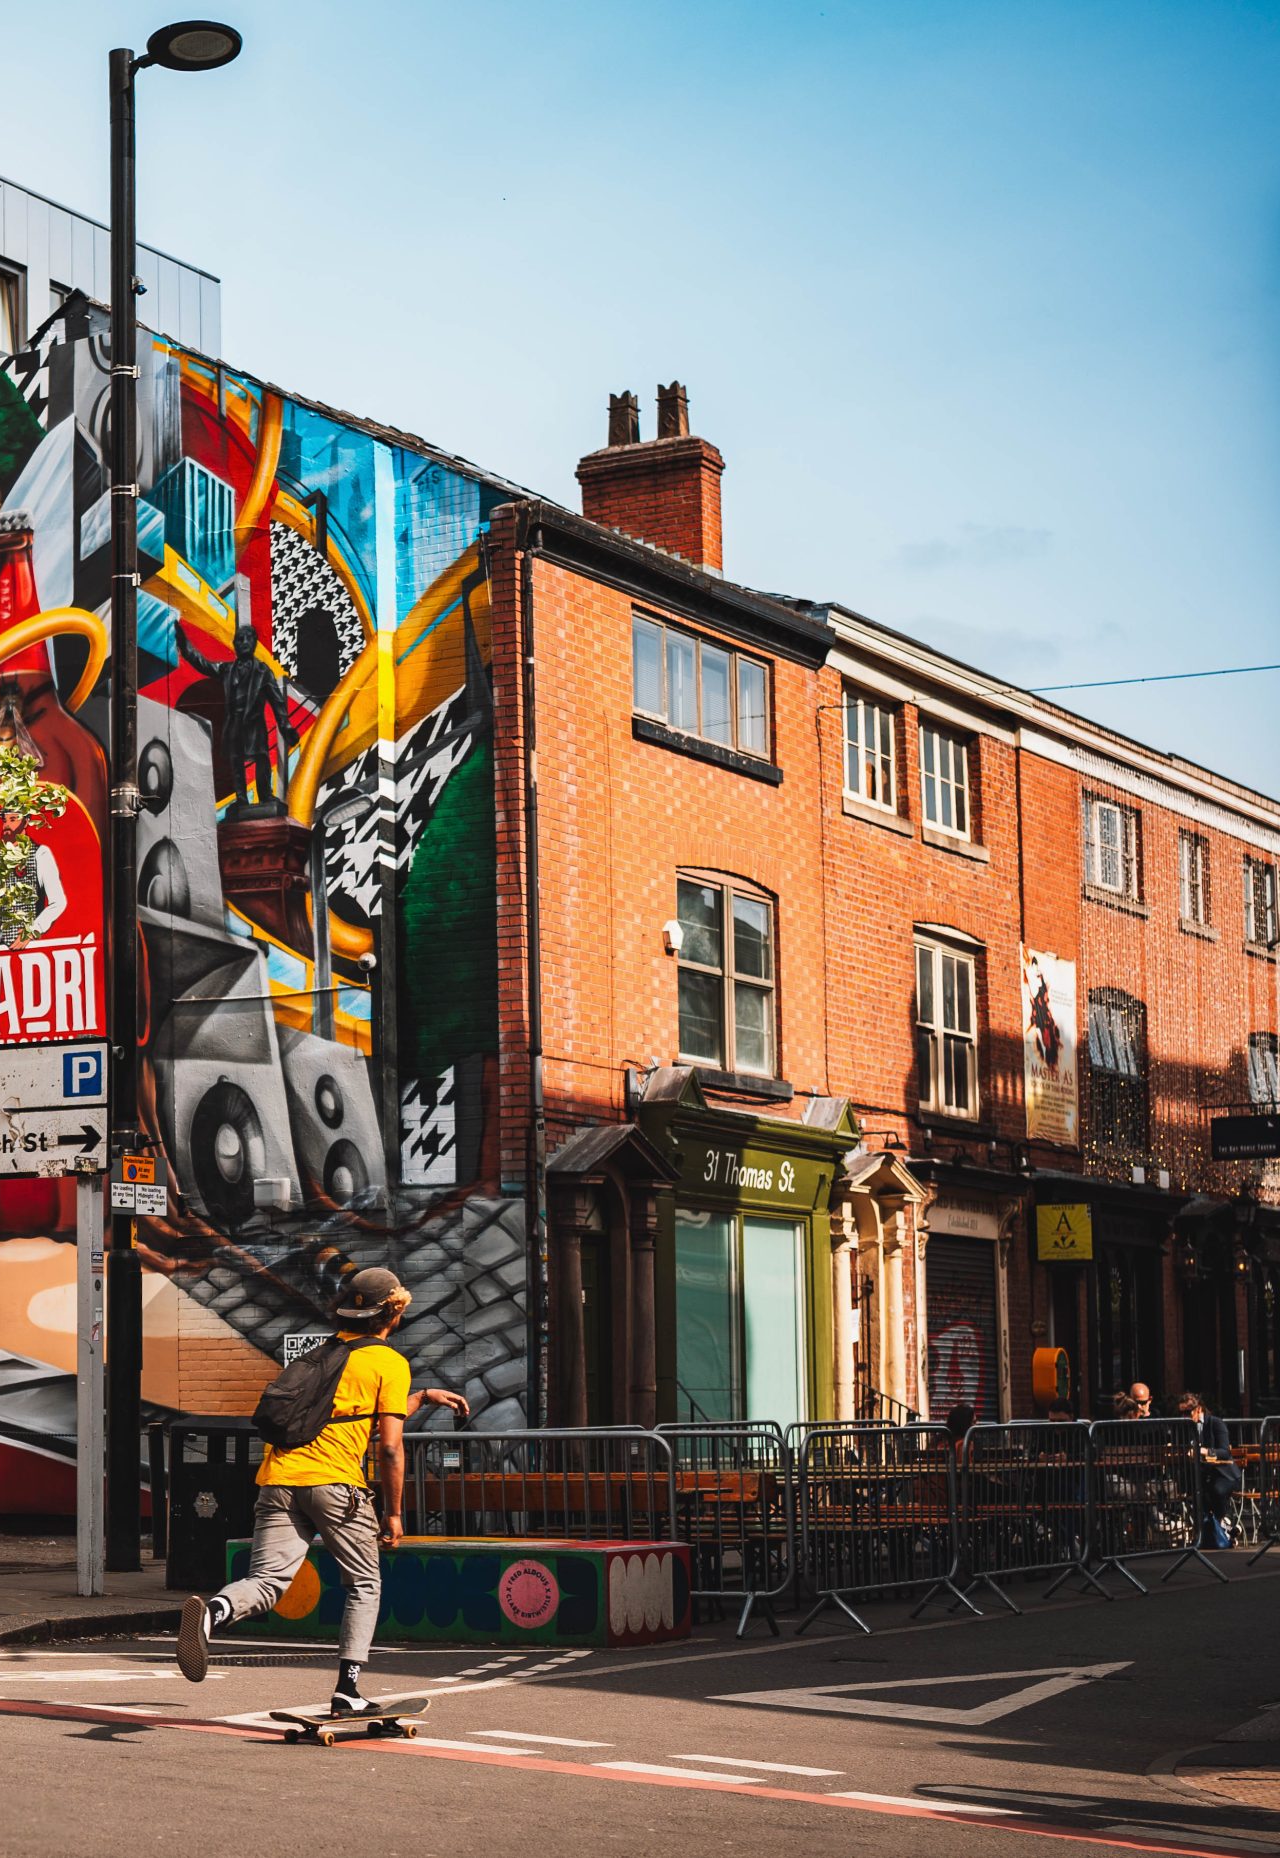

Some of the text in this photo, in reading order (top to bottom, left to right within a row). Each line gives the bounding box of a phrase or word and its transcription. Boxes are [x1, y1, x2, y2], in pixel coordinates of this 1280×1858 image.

[23, 1131, 48, 1153] St
[703, 1149, 795, 1193] 31 Thomas St.
[508, 1570, 523, 1586] FRED
[522, 1568, 550, 1586] ALDOUS
